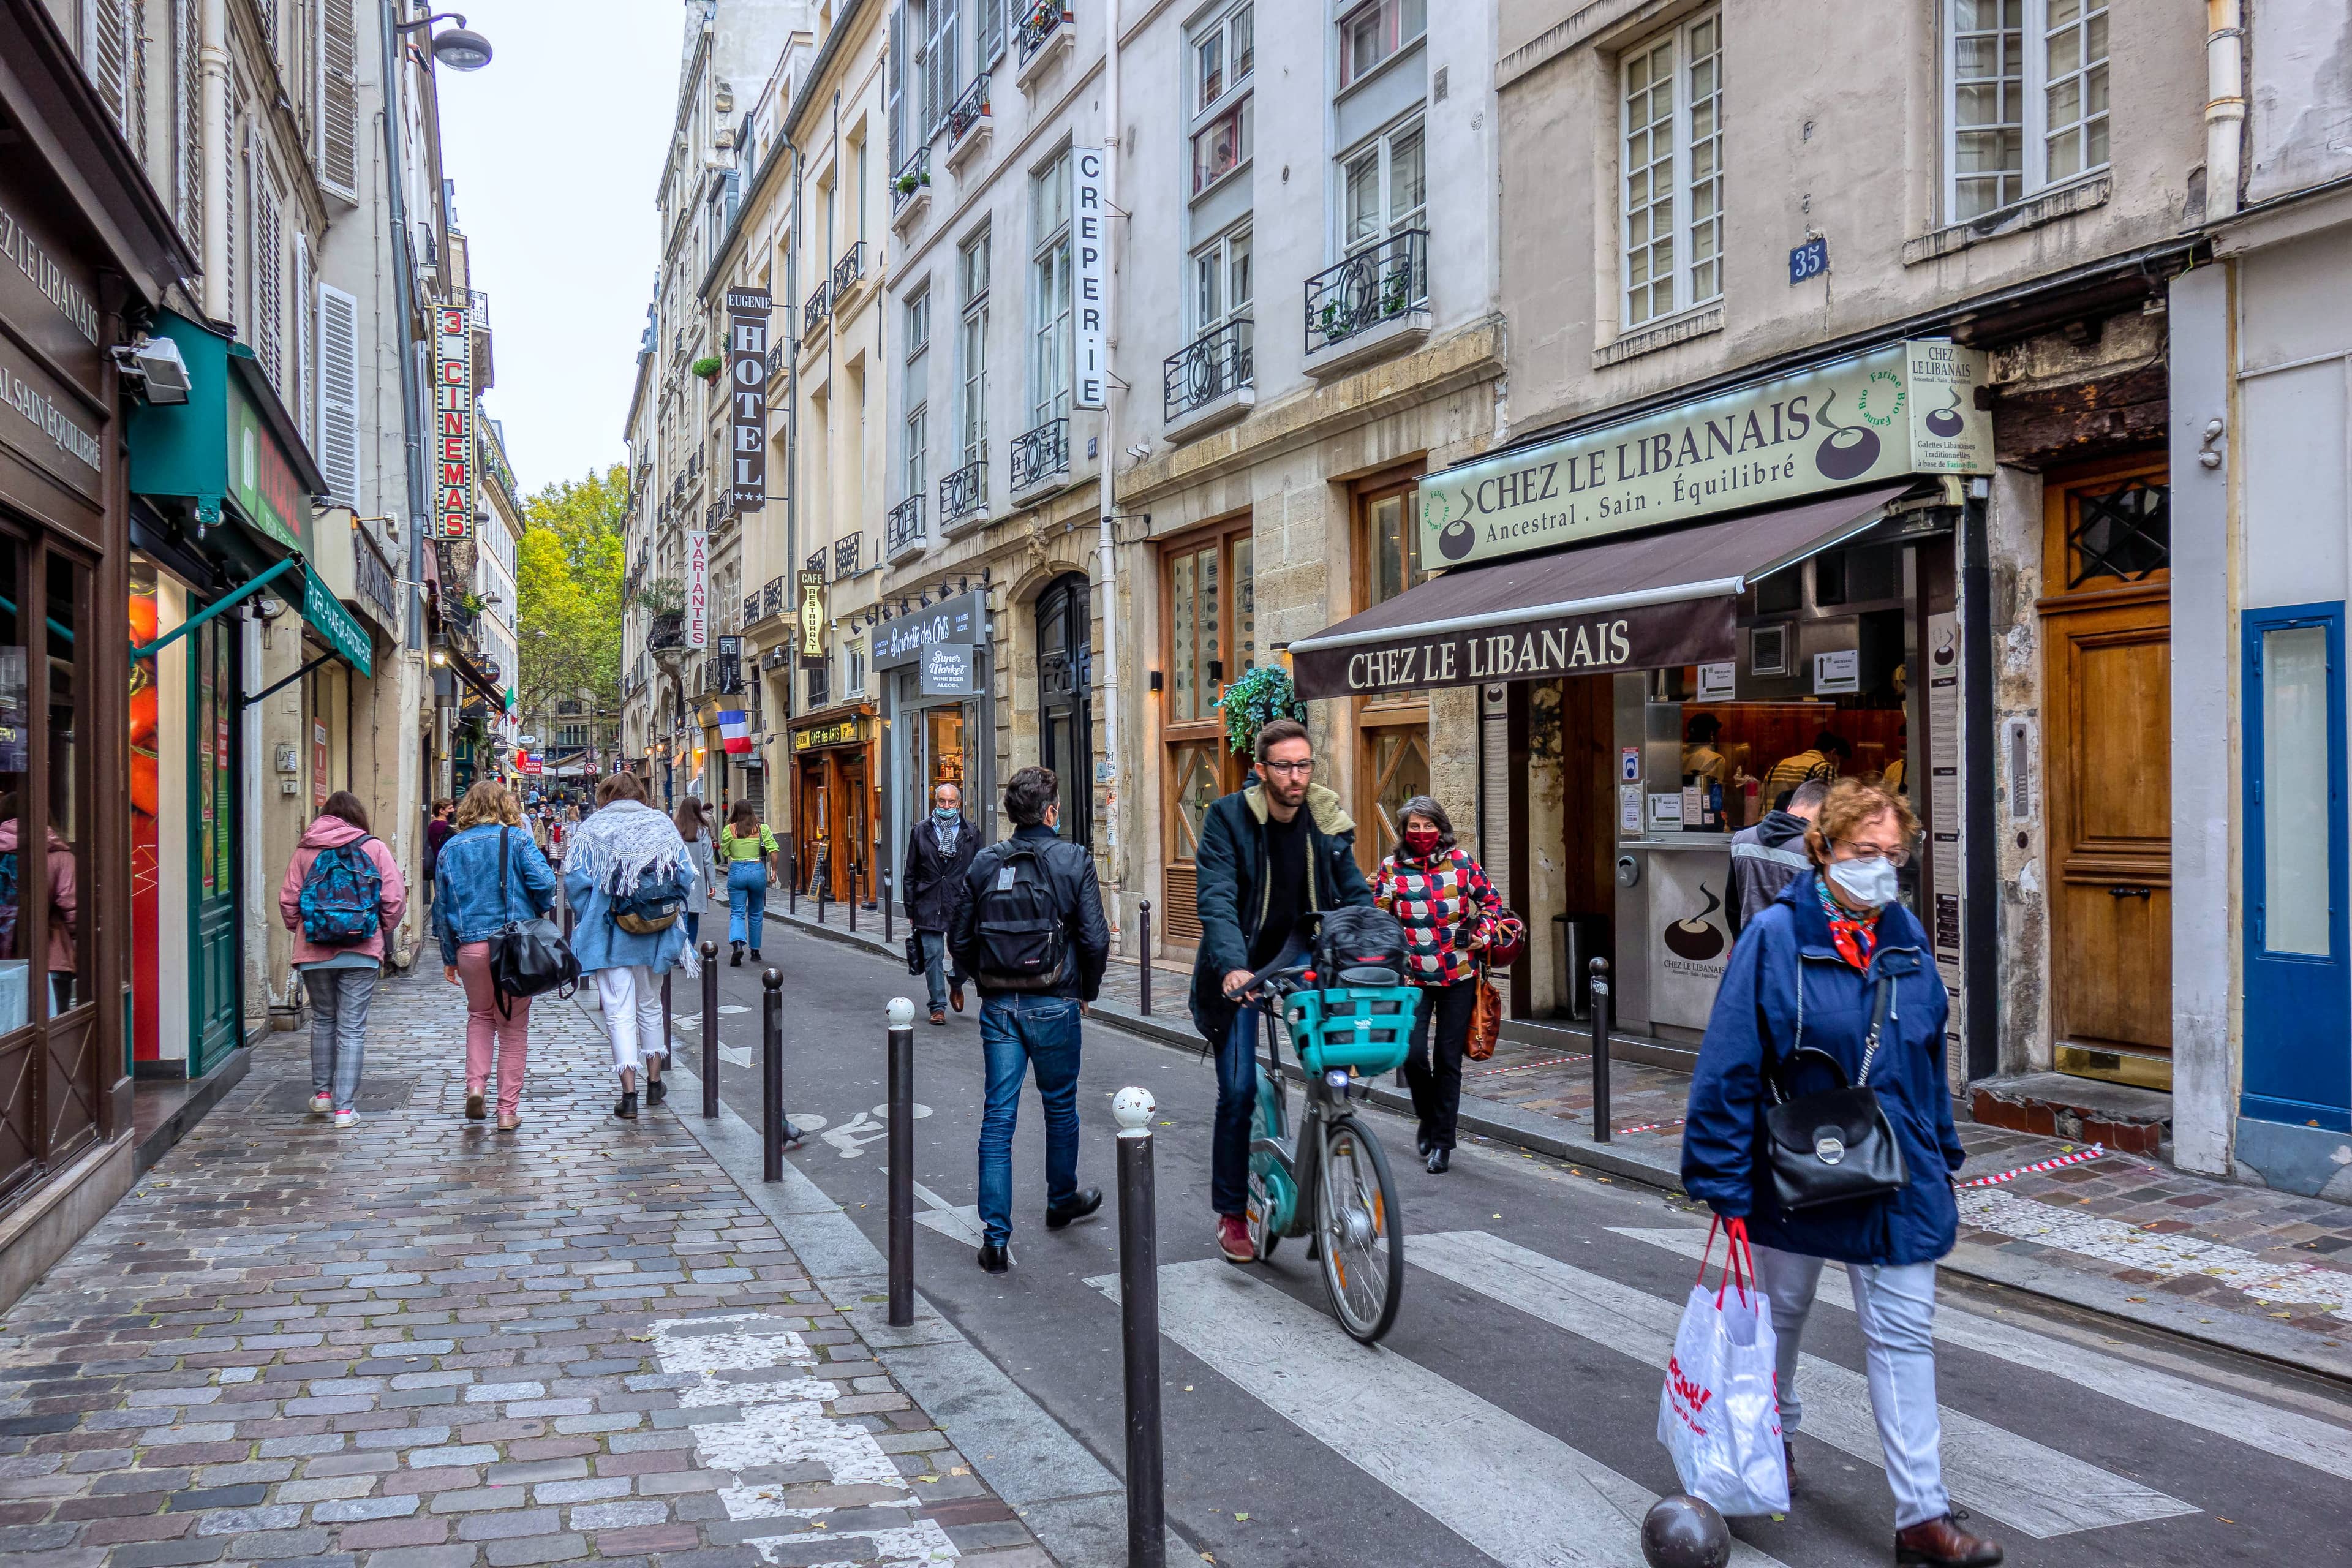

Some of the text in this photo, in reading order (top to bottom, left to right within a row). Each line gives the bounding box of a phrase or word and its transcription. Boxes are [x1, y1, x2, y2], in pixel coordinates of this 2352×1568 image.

[1795, 244, 1820, 277] 35
[17, 226, 35, 282] LE
[38, 249, 99, 347] LIBANAIS
[728, 293, 771, 309] EUGENIE
[1912, 360, 1971, 377] LE LIBANAIS
[1929, 347, 1954, 361] CHEZ
[734, 325, 765, 486] HOTEL
[1858, 369, 1905, 428] Farine Bio Farine Bio
[14, 378, 45, 430] SAIN
[47, 396, 101, 473] ÉQUILIBRÉ
[444, 312, 465, 535] 3 CINEMAS
[1477, 396, 1811, 514] CHEZ LE LIBANAIS
[1917, 440, 1975, 450] Galettes Libanaises
[1924, 450, 1970, 459] Traditionnelles
[1486, 453, 1795, 543] Ancestral Sain Équilibré
[692, 537, 704, 644] VARIANTES
[802, 573, 822, 584] CAFE
[921, 620, 932, 643] des
[933, 614, 949, 644] Arts
[929, 663, 967, 676] Market
[932, 650, 962, 665] Super
[1348, 620, 1630, 690] CHEZ LE LIBANAIS
[811, 730, 820, 745] CAFE
[829, 727, 839, 741] ARTS
[1664, 960, 1681, 969] CHEZ
[1692, 963, 1725, 974] LIBANAIS
